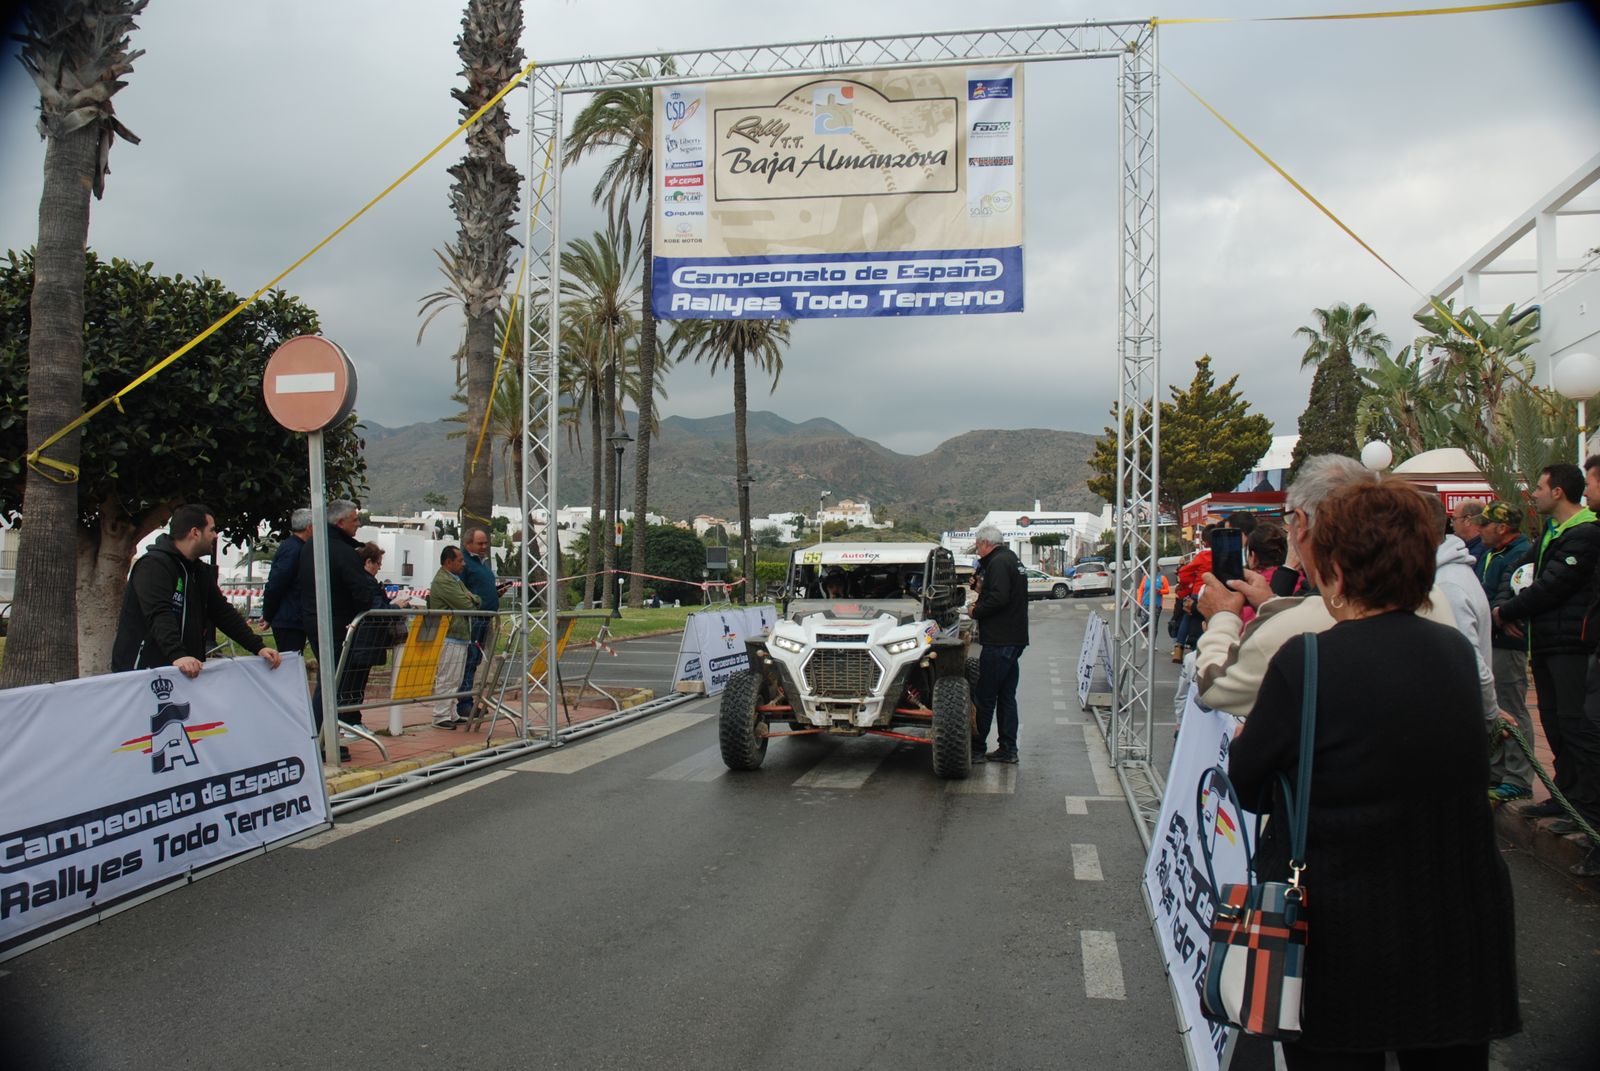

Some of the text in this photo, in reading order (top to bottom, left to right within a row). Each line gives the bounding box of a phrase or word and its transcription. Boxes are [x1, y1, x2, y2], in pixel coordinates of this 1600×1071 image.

[666, 101, 686, 121] CSD
[727, 115, 790, 147] Rally
[722, 143, 948, 184] Baja Almanzora
[678, 260, 998, 287] Campeonato de España
[671, 288, 1005, 316] Rallyes Todo Terreno
[803, 551, 822, 563] 55
[841, 552, 880, 561] Autofex
[0, 760, 301, 864] Campeonato de España
[0, 794, 312, 920] Rallyes Todo Terreno
